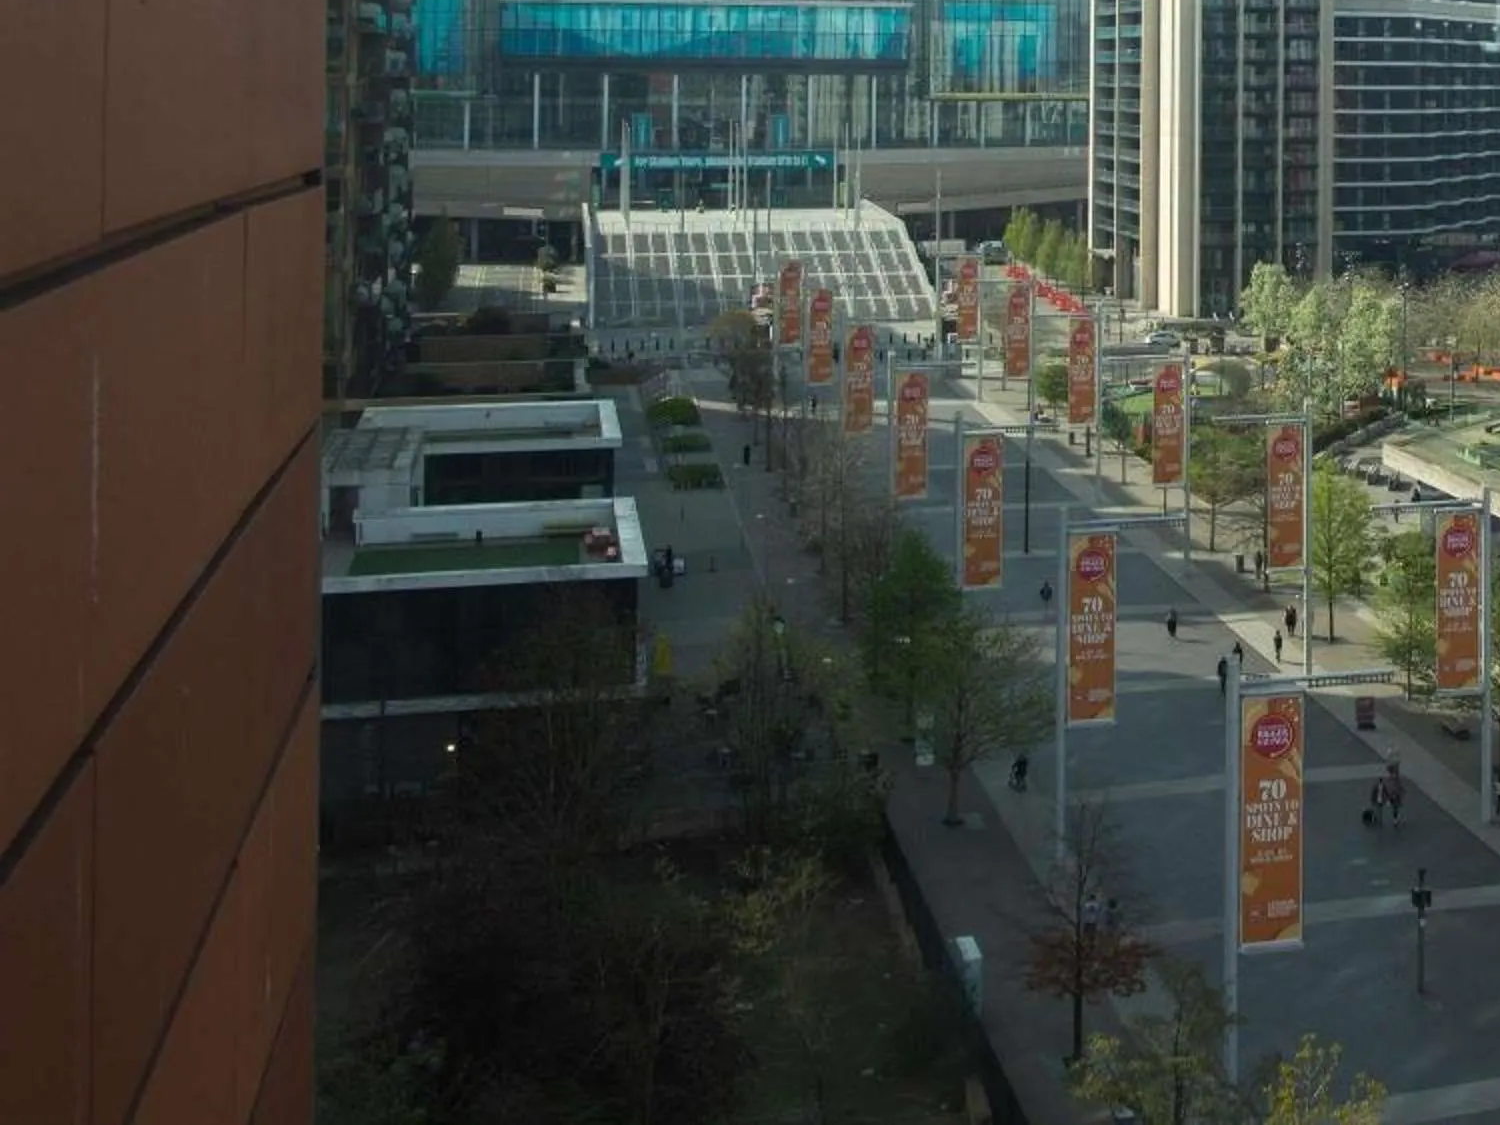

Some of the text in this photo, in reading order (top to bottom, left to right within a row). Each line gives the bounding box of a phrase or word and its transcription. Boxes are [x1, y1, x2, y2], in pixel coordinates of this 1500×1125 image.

[1450, 571, 1468, 587] 70
[1081, 596, 1103, 613] 70
[1259, 778, 1288, 801] 70
[1247, 810, 1282, 828] DINE
[1251, 826, 1293, 844] SHOP
